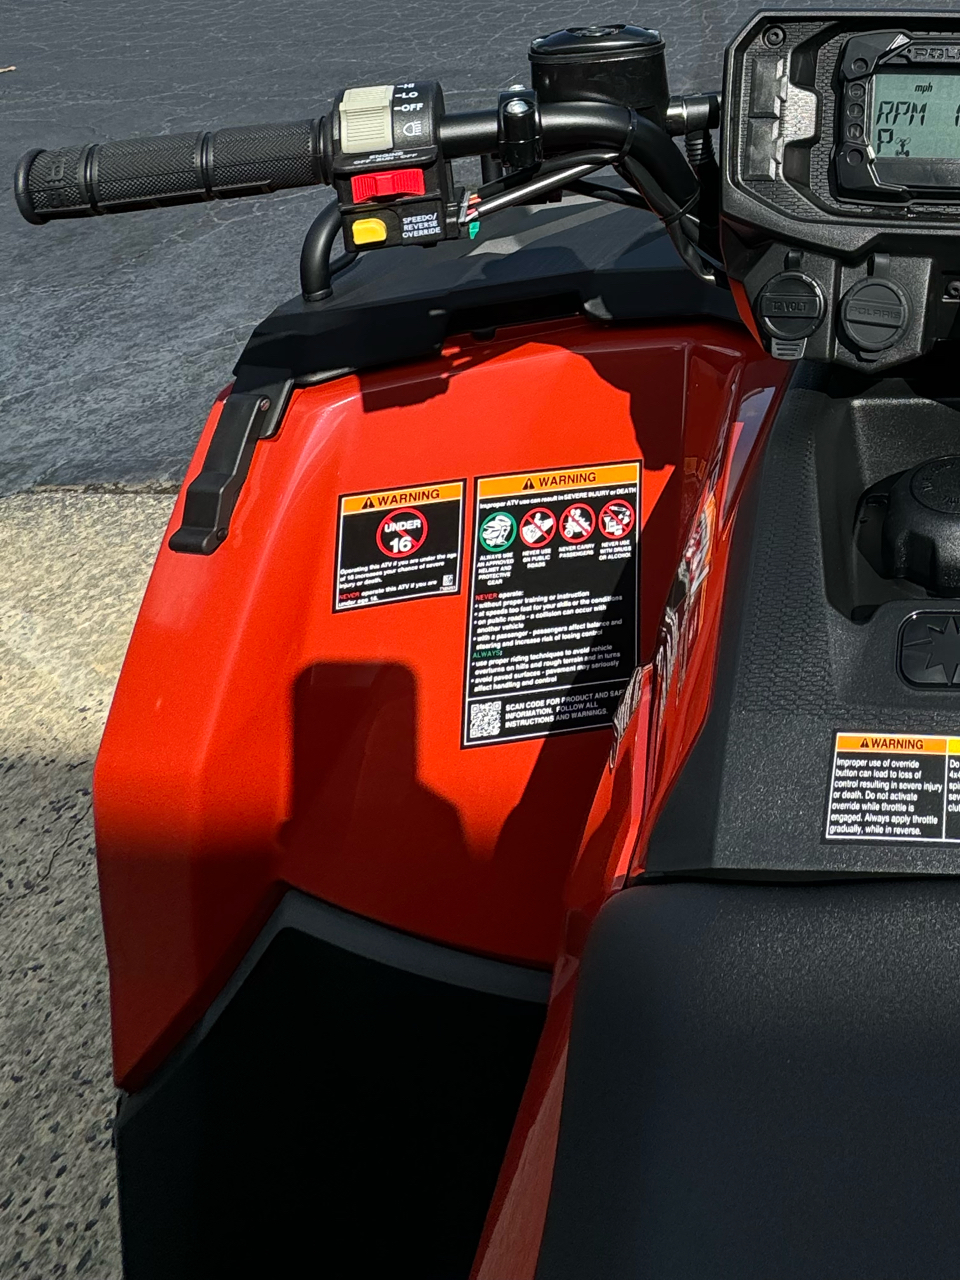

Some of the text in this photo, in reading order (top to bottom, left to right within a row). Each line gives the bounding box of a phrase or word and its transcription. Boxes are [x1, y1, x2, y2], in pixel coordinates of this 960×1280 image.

[914, 82, 933, 94] mph
[401, 103, 424, 111] OFF
[876, 101, 927, 126] RPM
[876, 128, 893, 155] P
[402, 212, 437, 224] SPEEDO/
[403, 221, 438, 231] REVERSE
[402, 227, 441, 238] OVERRIDE
[784, 301, 808, 312] VOLT
[850, 306, 901, 319] POLARIS
[538, 472, 595, 486] WARNING
[377, 489, 439, 505] WARNING
[384, 519, 420, 532] UNDER
[388, 535, 413, 554] 16
[505, 702, 524, 711] SCAN
[525, 699, 544, 708] CODE
[545, 697, 560, 705] FOR
[560, 693, 592, 703] PRODUCT
[505, 707, 552, 719] INFORMATION.
[555, 703, 584, 712] FOLLOW
[504, 715, 554, 727] INSTRUCTIONS
[871, 738, 923, 749] WARNING
[836, 757, 919, 768] Improper use of override
[949, 758, 959, 768] Do
[835, 768, 857, 776] button
[873, 769, 888, 778] lead
[889, 769, 897, 778] to
[898, 769, 912, 778] loss
[913, 770, 921, 779] of
[834, 779, 942, 792] control resulting in severe injury
